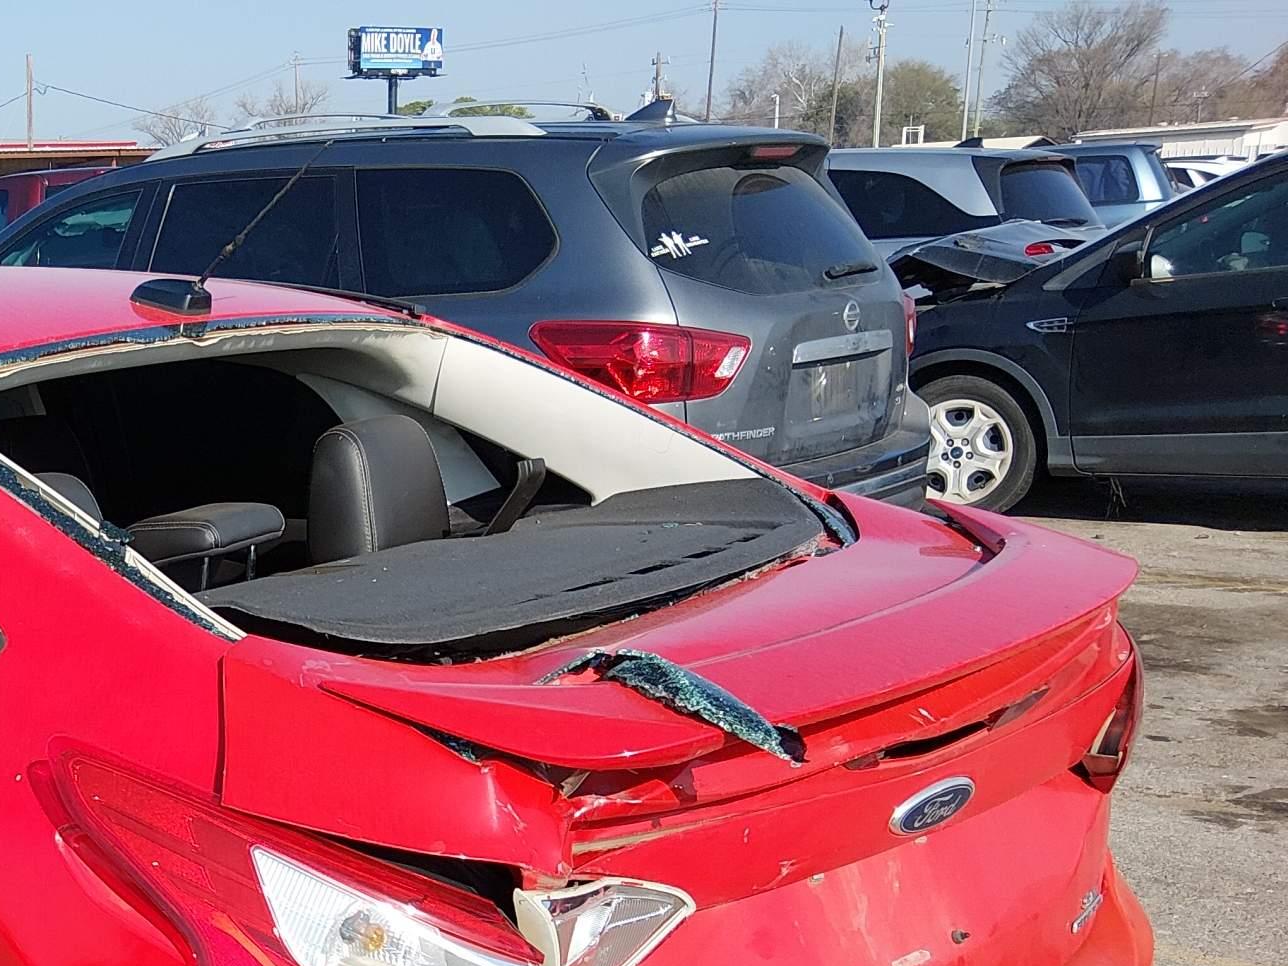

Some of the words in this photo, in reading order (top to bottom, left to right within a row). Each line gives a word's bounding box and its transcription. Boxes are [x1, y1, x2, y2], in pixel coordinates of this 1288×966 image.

[361, 32, 388, 53] MIKE
[389, 33, 422, 53] DOYLE
[914, 793, 962, 828] Ford
